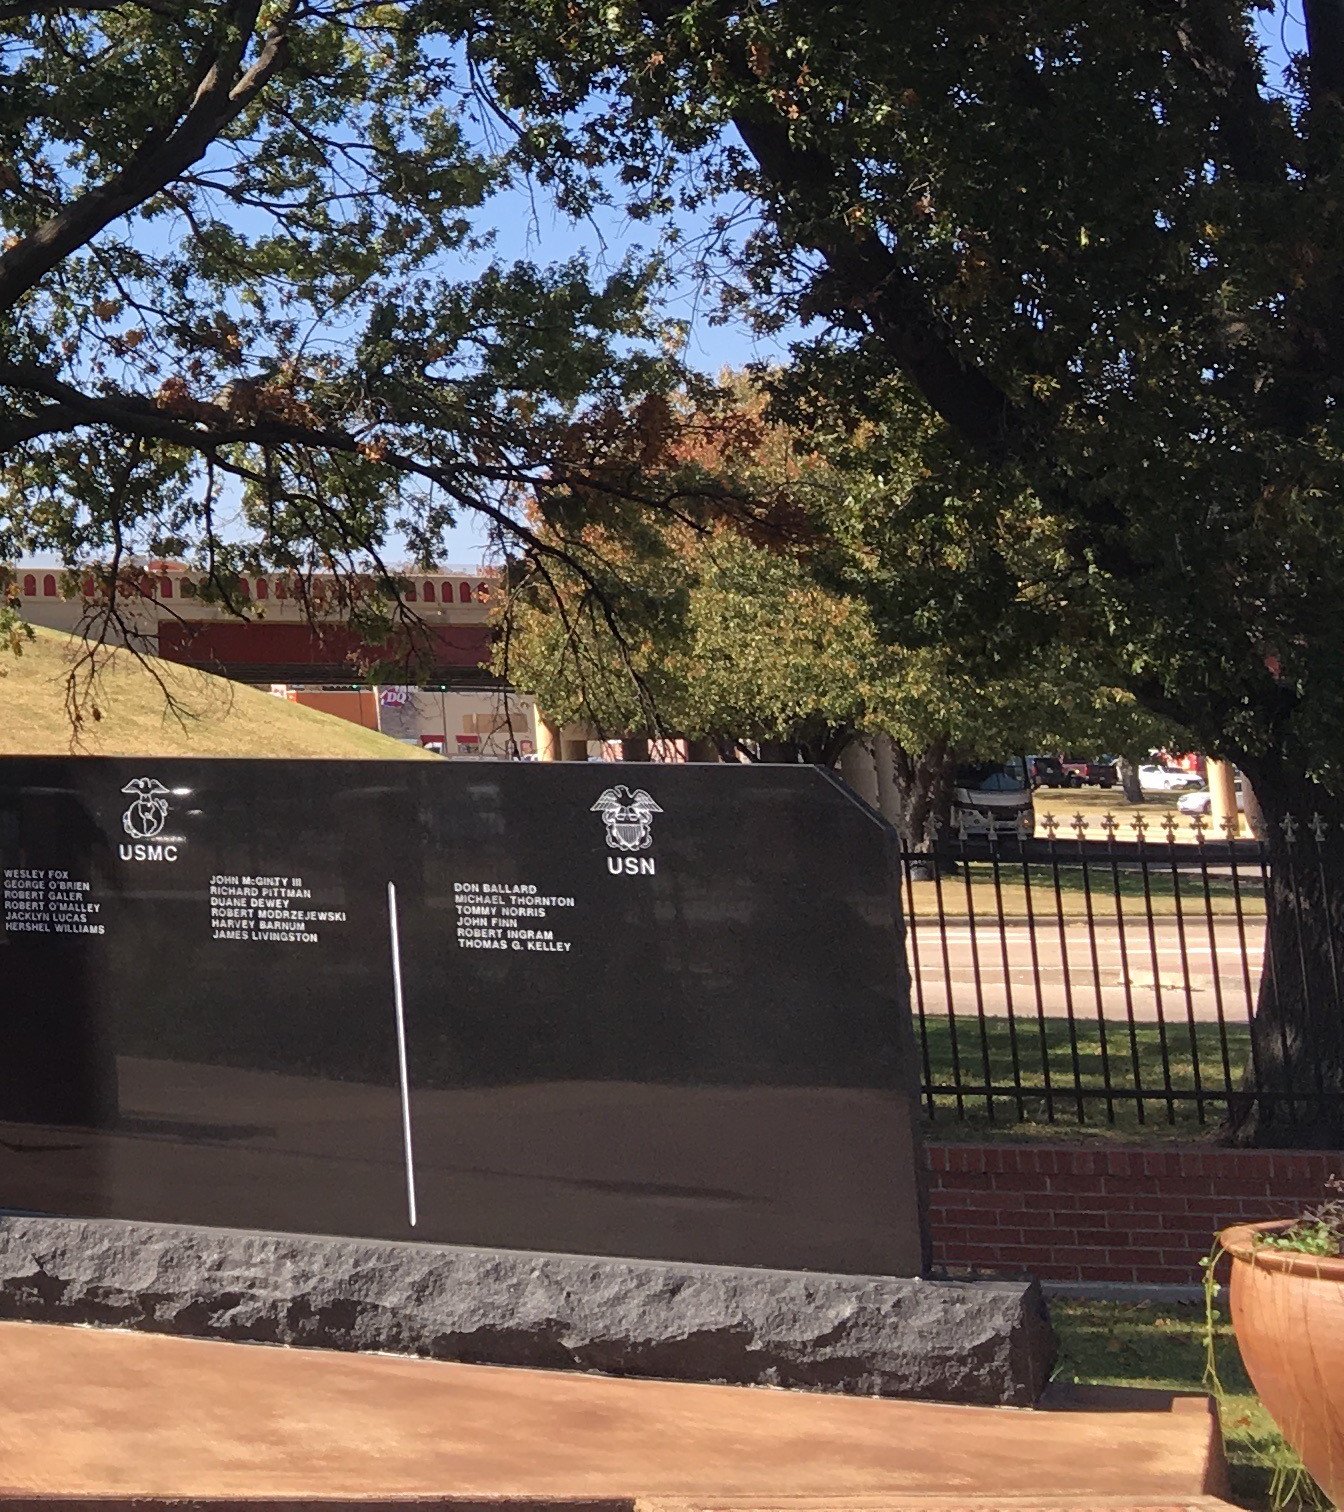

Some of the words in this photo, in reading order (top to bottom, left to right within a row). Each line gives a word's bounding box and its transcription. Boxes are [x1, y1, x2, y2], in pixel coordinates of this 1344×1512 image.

[387, 692, 407, 703] DQ
[118, 844, 178, 862] USMC
[607, 856, 655, 875] USN
[4, 870, 44, 878] WESLEY
[48, 871, 68, 879] FOX
[210, 875, 238, 884] JOHN
[4, 880, 45, 889] GEORGE
[454, 883, 479, 892] DON
[483, 884, 537, 894] BALLARD
[4, 891, 44, 899] ROBERT
[48, 892, 83, 901] GALER
[210, 886, 258, 896] RICHARD
[262, 888, 311, 898] PITTMAN
[4, 901, 44, 910] ROBERT
[210, 897, 247, 906] DUANE
[250, 898, 289, 908] DEWEY
[455, 895, 505, 904] MICHAEL
[510, 896, 574, 906] THORNTON
[5, 912, 49, 921] JACKLYN
[53, 913, 87, 922] LUCAS
[211, 908, 254, 918] ROBERT
[258, 910, 346, 921] MODRZEJEWSKI
[456, 906, 497, 915] TOMMY
[502, 907, 546, 917] NORRIS
[212, 919, 255, 928] HARVEY
[259, 921, 305, 930] BARNUM
[457, 917, 487, 926] JOHN
[492, 918, 517, 927] FINN
[5, 923, 50, 931] HERSHEL
[54, 924, 105, 934] WILLIAMS
[457, 928, 503, 937] ROBERT
[507, 930, 553, 939] INGRAM
[212, 930, 248, 940] JAMES
[252, 931, 318, 942] LIVINGSTON
[458, 939, 507, 949] THOMAS
[512, 941, 523, 950] G.
[528, 942, 571, 951] KELLEY
